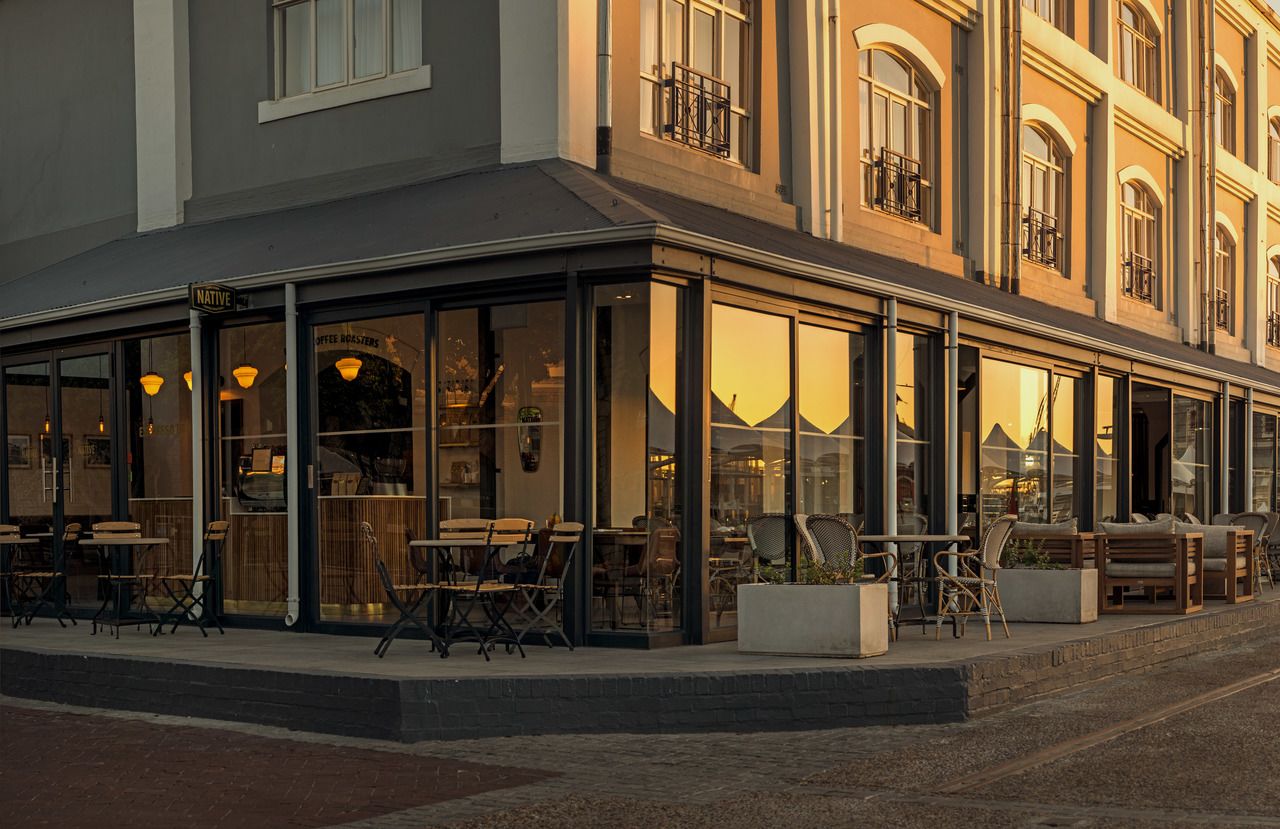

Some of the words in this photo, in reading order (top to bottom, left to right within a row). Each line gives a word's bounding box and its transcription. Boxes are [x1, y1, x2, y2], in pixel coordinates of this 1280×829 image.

[197, 289, 231, 306] NATIVE
[316, 334, 338, 345] OFFEE
[340, 333, 379, 348] ROASTERS
